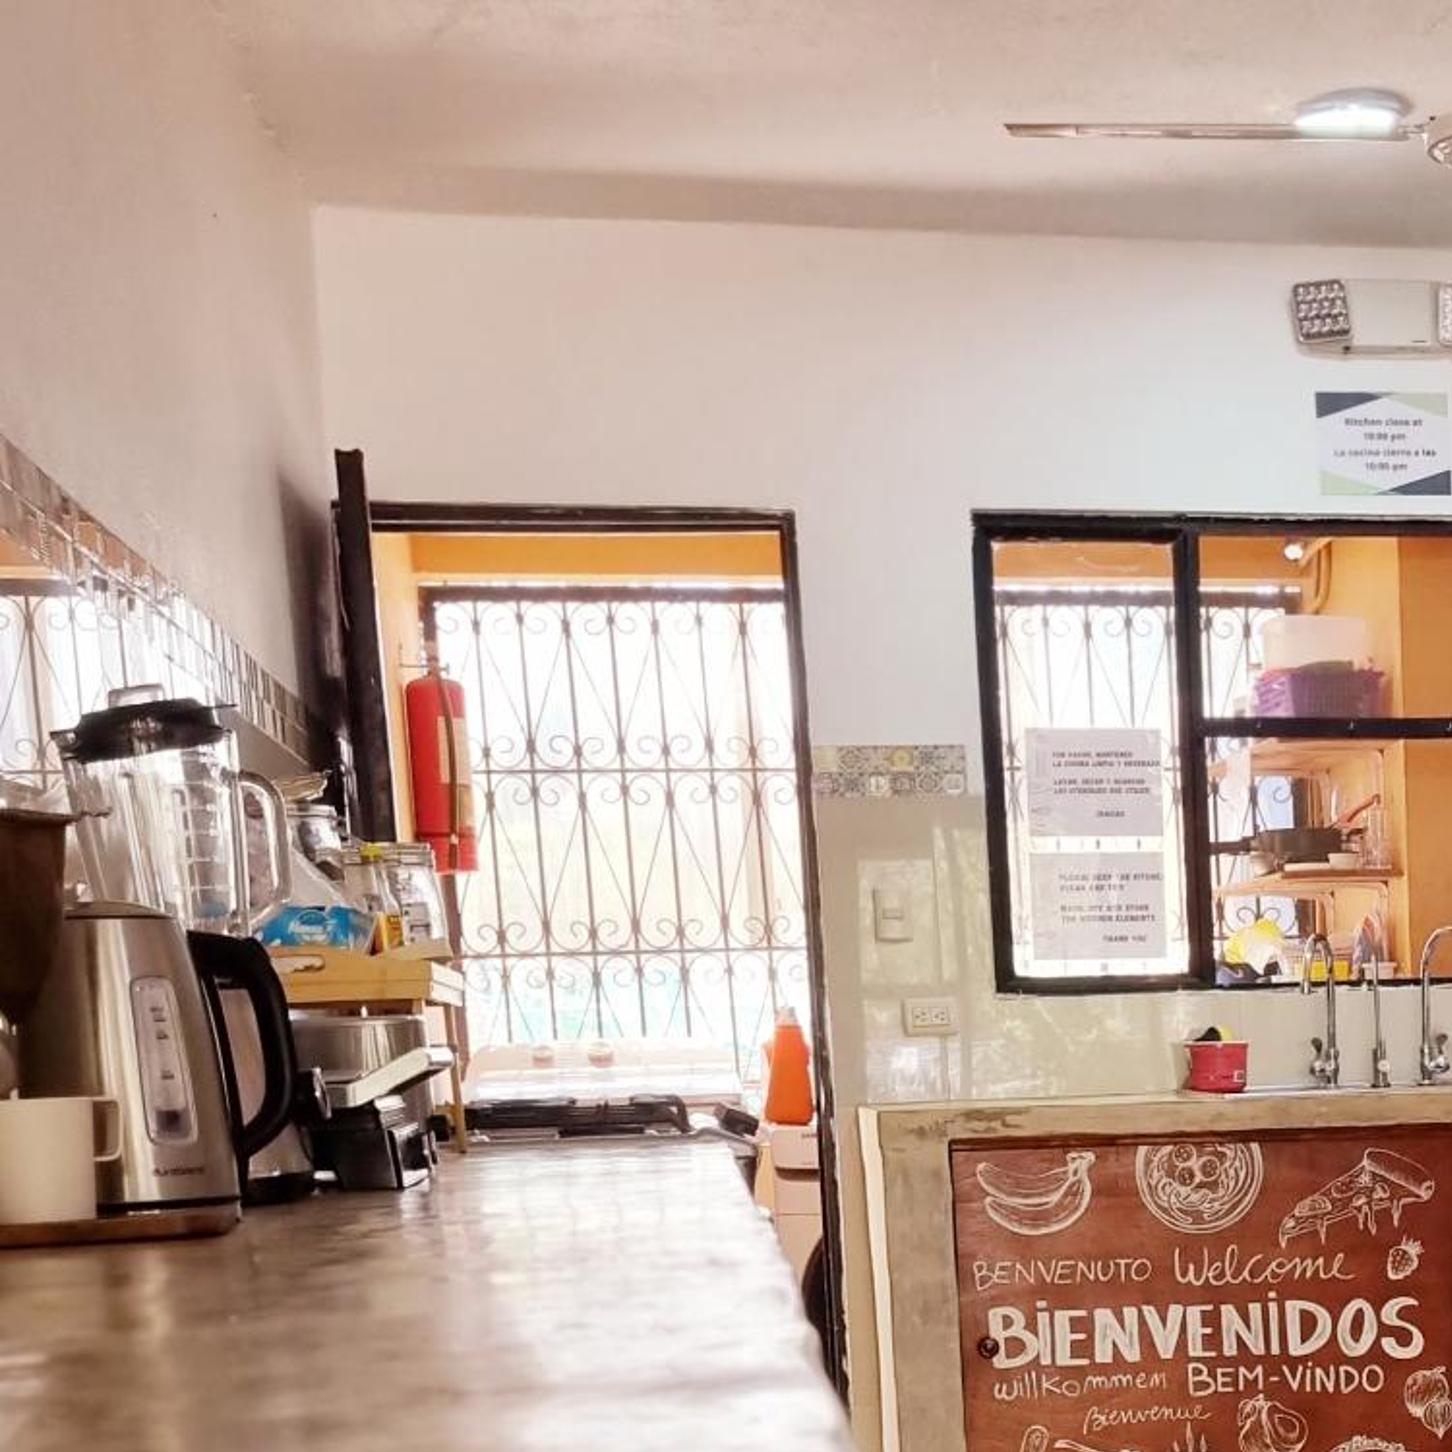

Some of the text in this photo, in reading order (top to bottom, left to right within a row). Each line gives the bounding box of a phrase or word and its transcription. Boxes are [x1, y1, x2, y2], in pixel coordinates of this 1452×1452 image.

[973, 1243, 1358, 1291] BENVENUTO Welcome
[1083, 1402, 1213, 1435] Bienvenue
